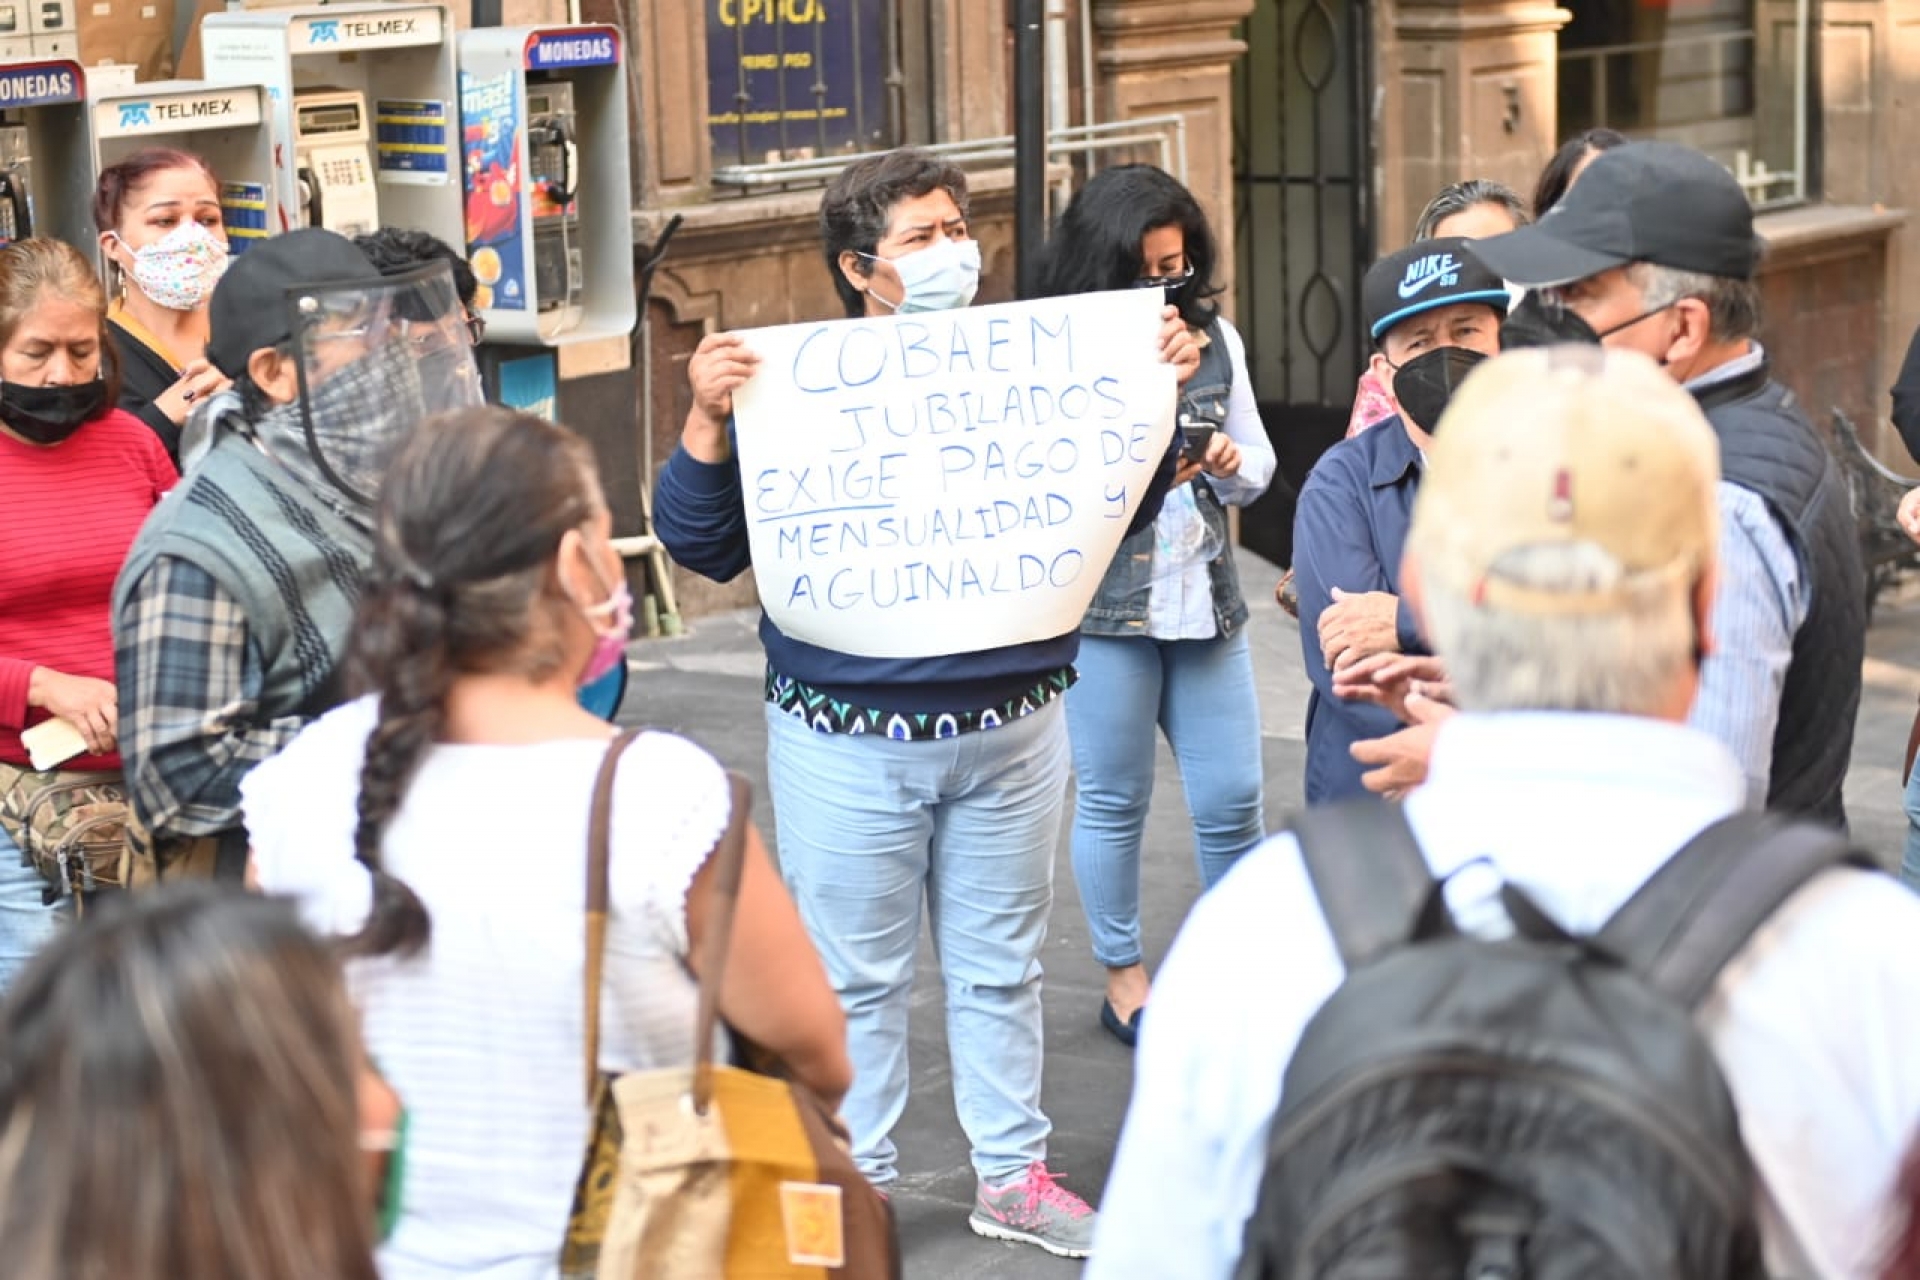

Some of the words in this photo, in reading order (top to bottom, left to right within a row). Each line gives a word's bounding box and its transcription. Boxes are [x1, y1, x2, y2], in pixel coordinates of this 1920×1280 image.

[343, 19, 416, 39] TELMEX
[539, 38, 613, 62] MONEDAS
[156, 99, 233, 120] TELMEX
[1405, 253, 1453, 284] NIKE
[792, 314, 1074, 393] COBAEM
[831, 376, 1127, 453] JUBILADOS
[756, 453, 908, 514] EXIGE
[939, 437, 1080, 492] PAGO
[1101, 424, 1151, 465] DE
[778, 493, 1074, 561] MENSUALIDAD
[787, 549, 1084, 611] AGUINALDO
